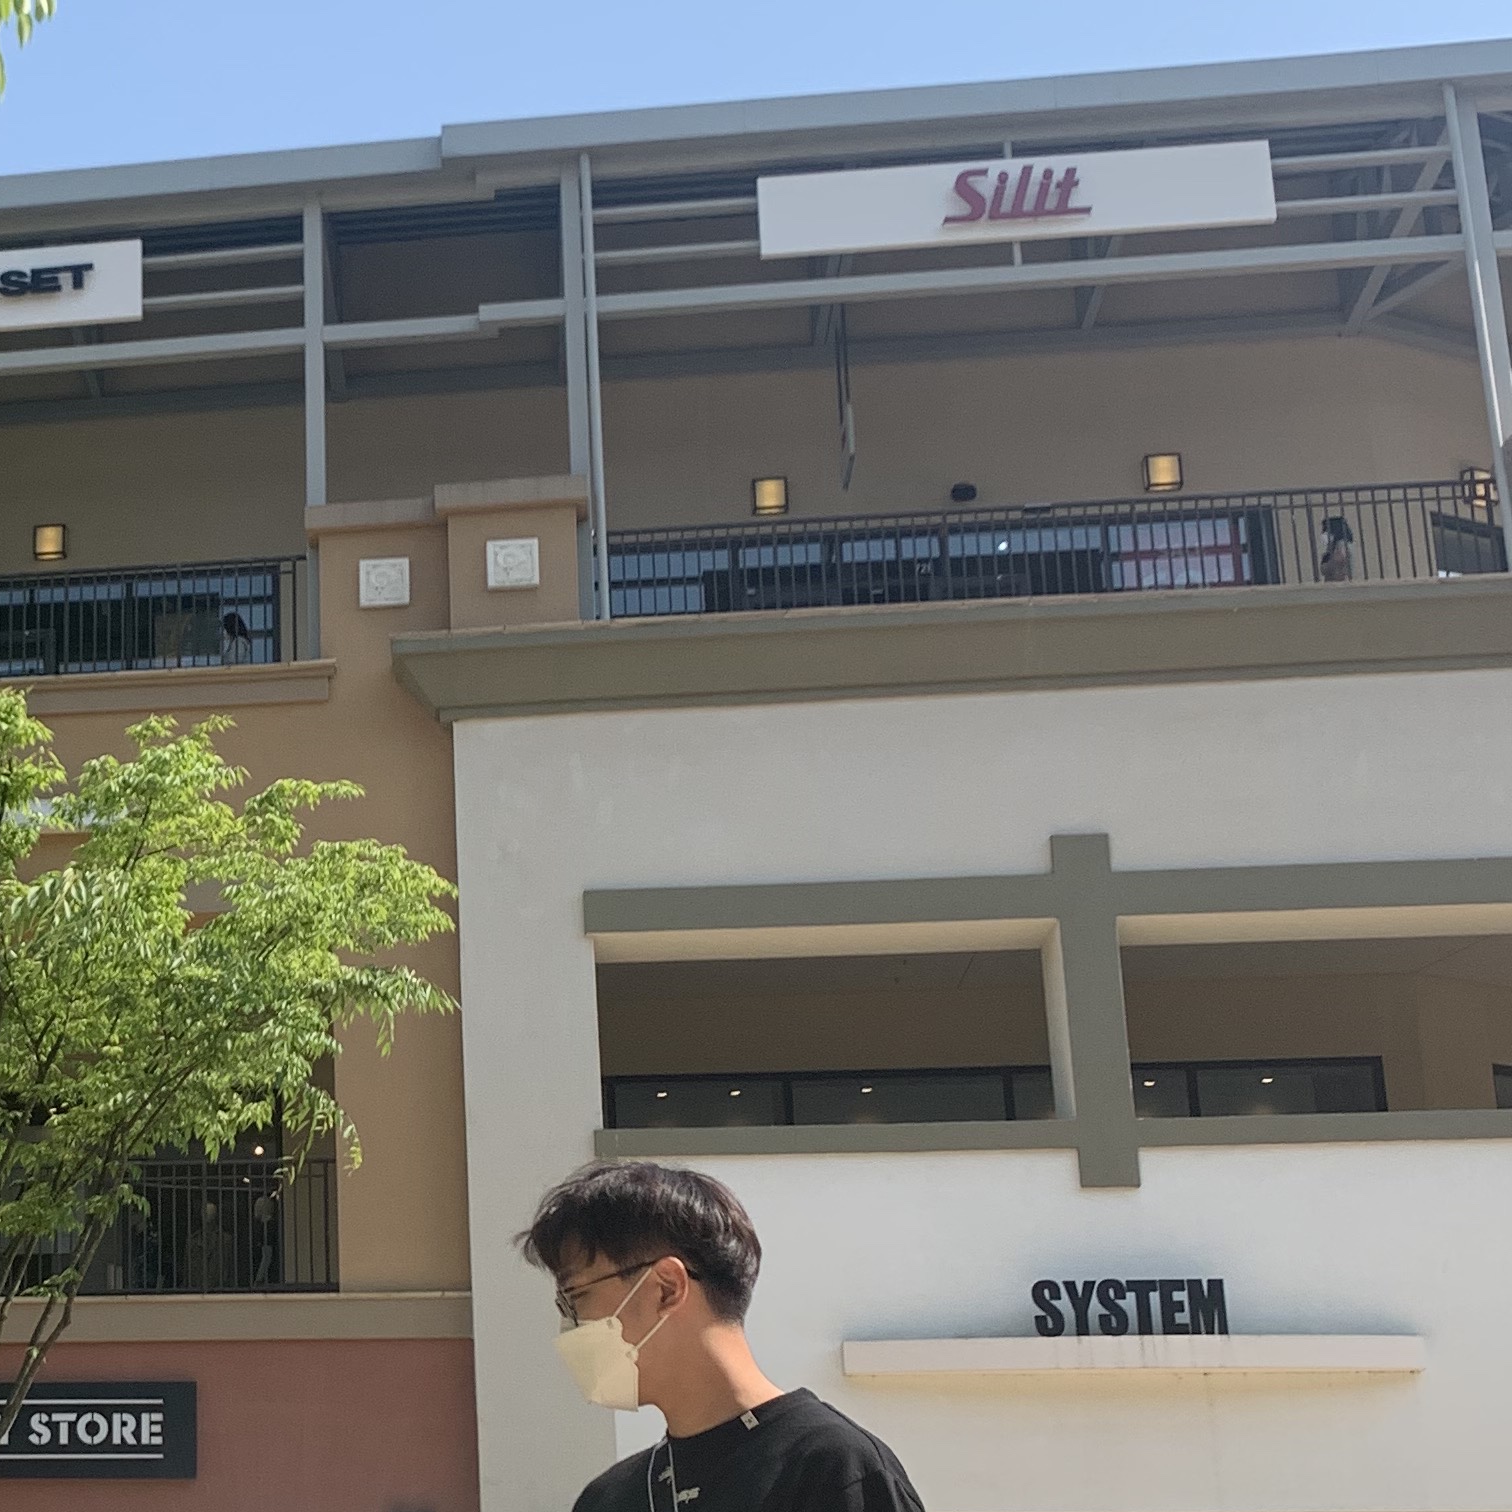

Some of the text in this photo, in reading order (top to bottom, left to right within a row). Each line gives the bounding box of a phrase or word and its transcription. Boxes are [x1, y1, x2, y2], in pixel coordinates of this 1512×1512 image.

[943, 164, 1092, 225] Silit
[1032, 1278, 1229, 1337] SYSTEM
[29, 1412, 164, 1446] STORE
